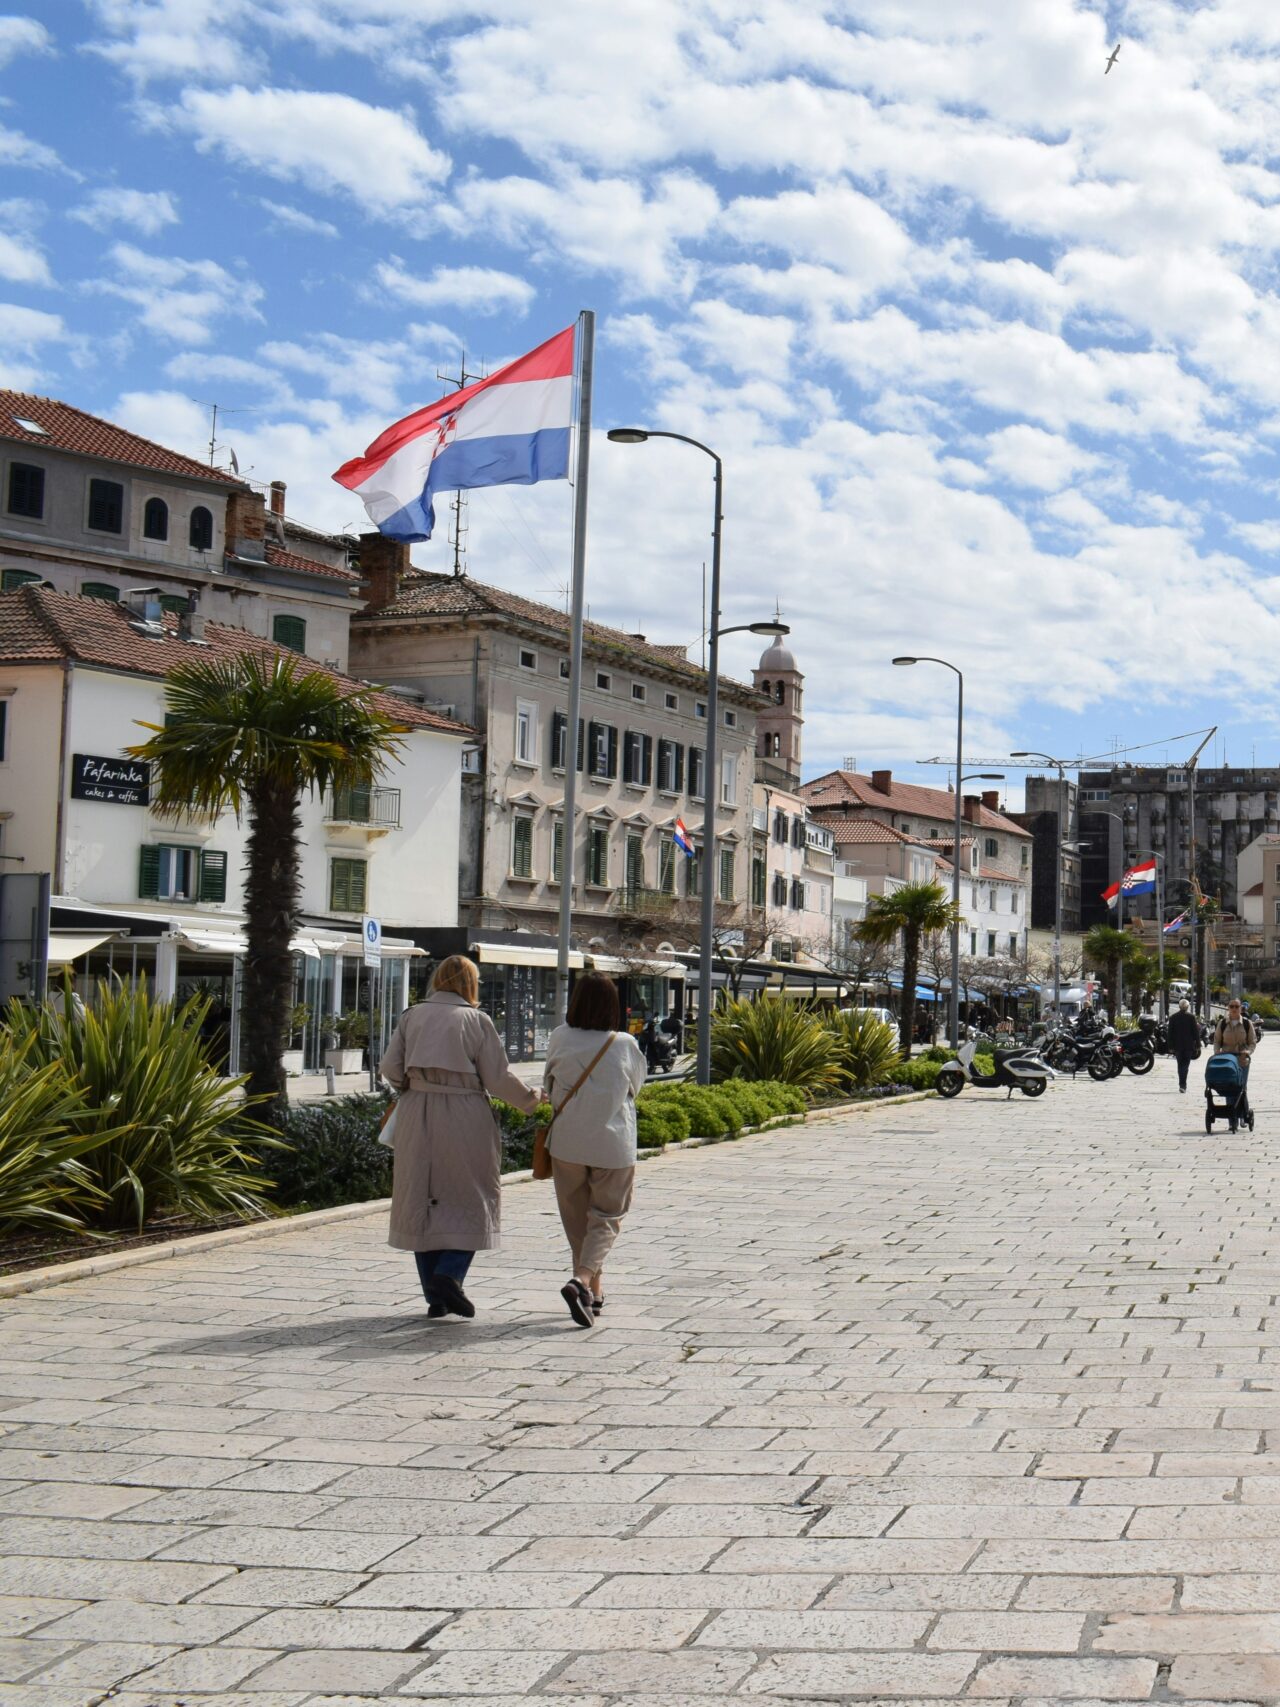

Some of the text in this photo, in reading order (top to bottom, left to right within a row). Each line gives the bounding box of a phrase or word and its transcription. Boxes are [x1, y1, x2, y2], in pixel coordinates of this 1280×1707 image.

[84, 787, 139, 803] cakes & coffee
